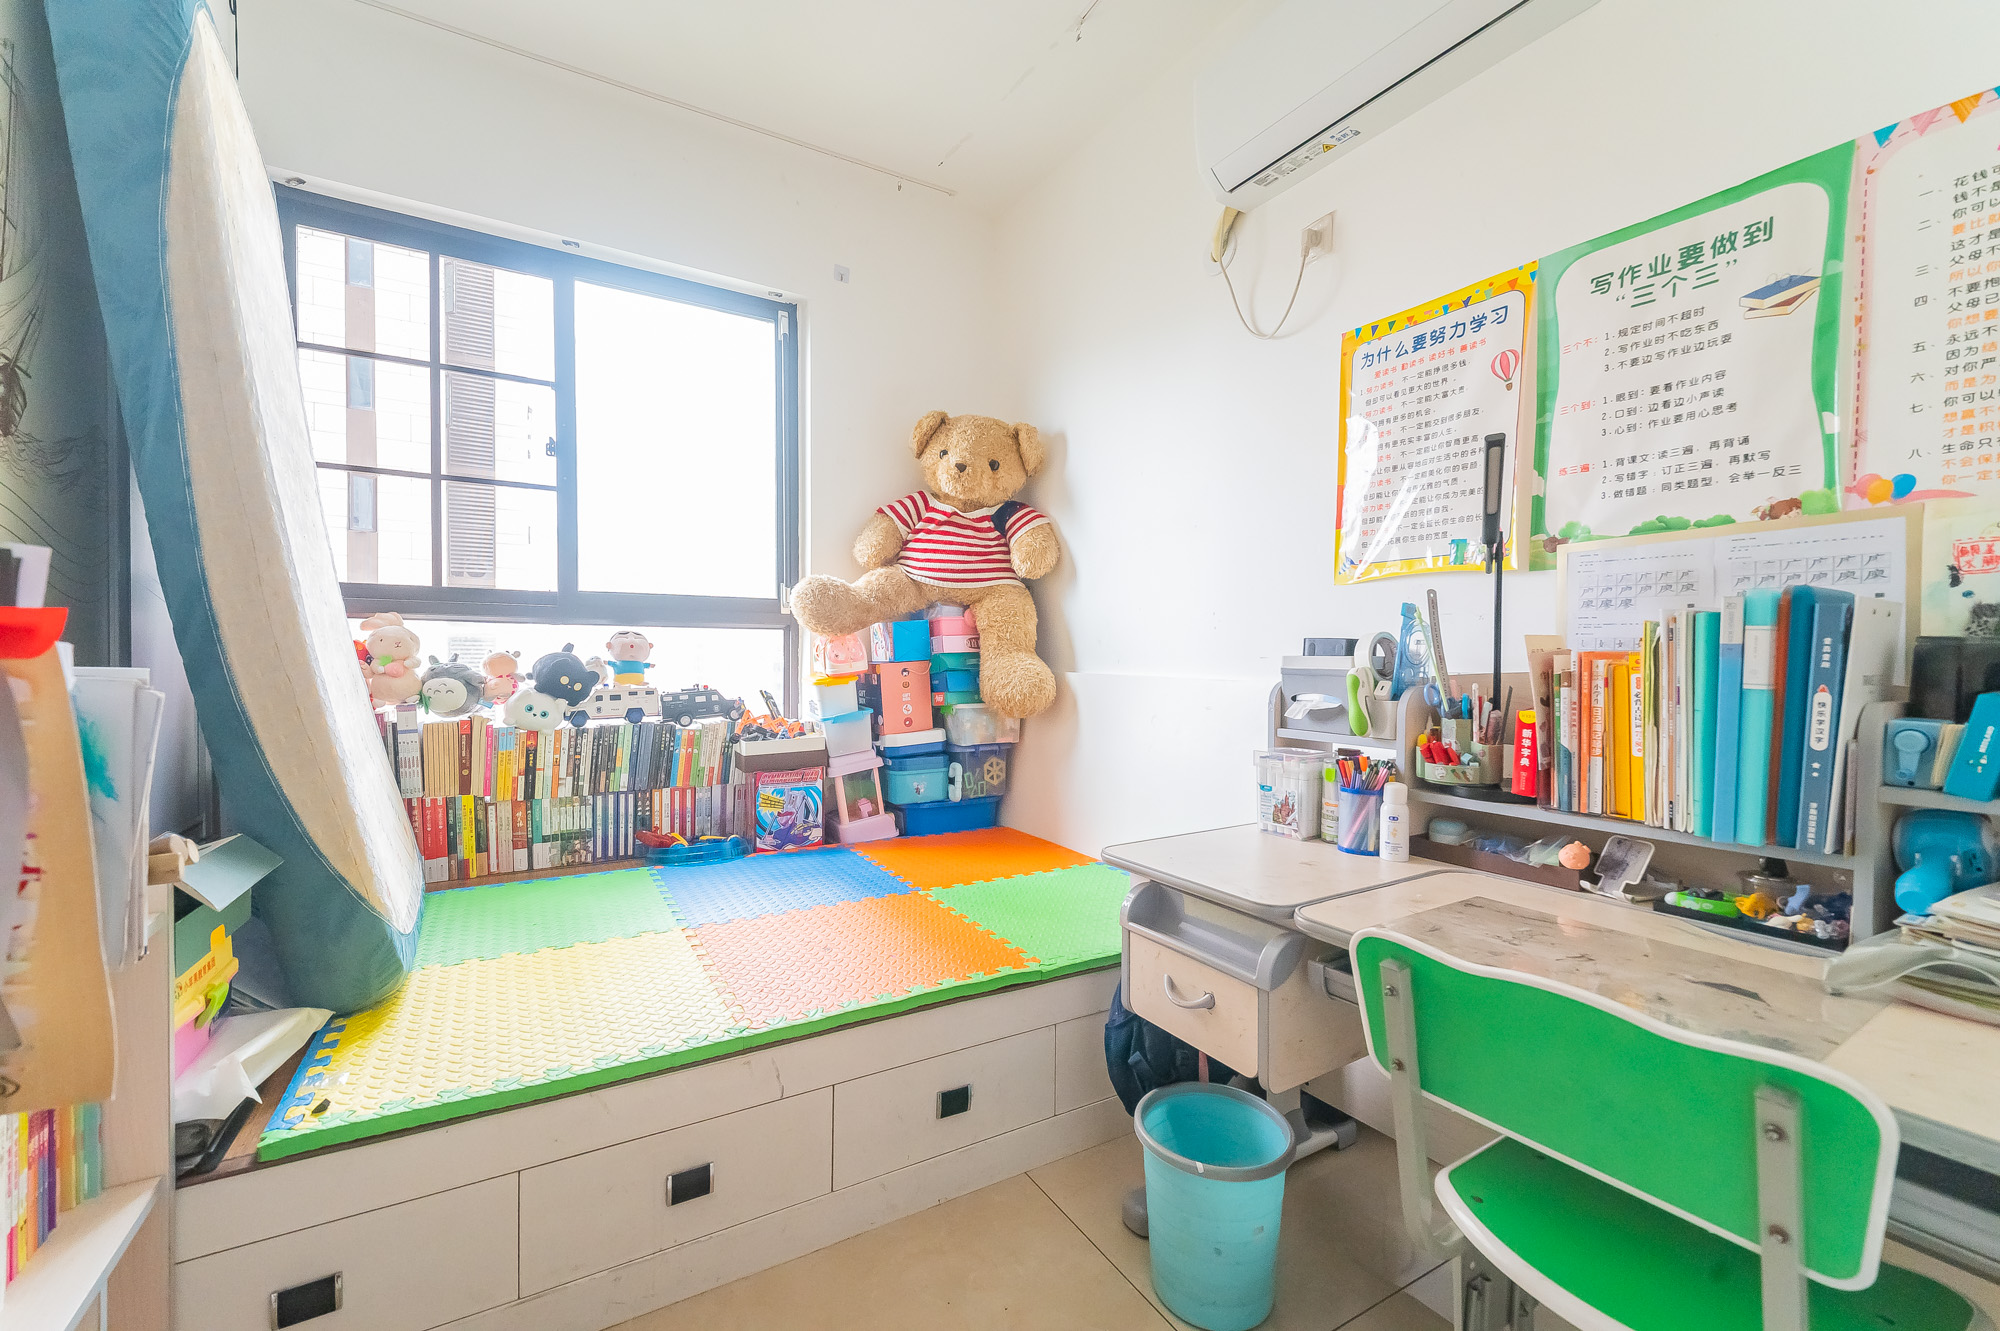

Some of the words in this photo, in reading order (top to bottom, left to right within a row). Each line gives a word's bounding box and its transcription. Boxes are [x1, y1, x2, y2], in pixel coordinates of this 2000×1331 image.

[1951, 228, 2000, 252] 这才是
[1590, 216, 1774, 295] 写作业要做到
[1950, 244, 2000, 268] 父母不
[1948, 259, 2000, 283] 所以你
[1946, 309, 1999, 331] 你想要
[1361, 305, 1509, 370] 为什么要努力学习
[1945, 325, 1998, 346] 永远不
[1428, 347, 1455, 362] 读好书
[1945, 341, 1998, 361] 因为结
[1944, 374, 1996, 392] 而是为
[1943, 389, 2000, 408] 你可以
[1943, 405, 2000, 423] 想赢不
[1942, 420, 2000, 438] 才是积
[1519, 728, 1533, 767] 新华字典
